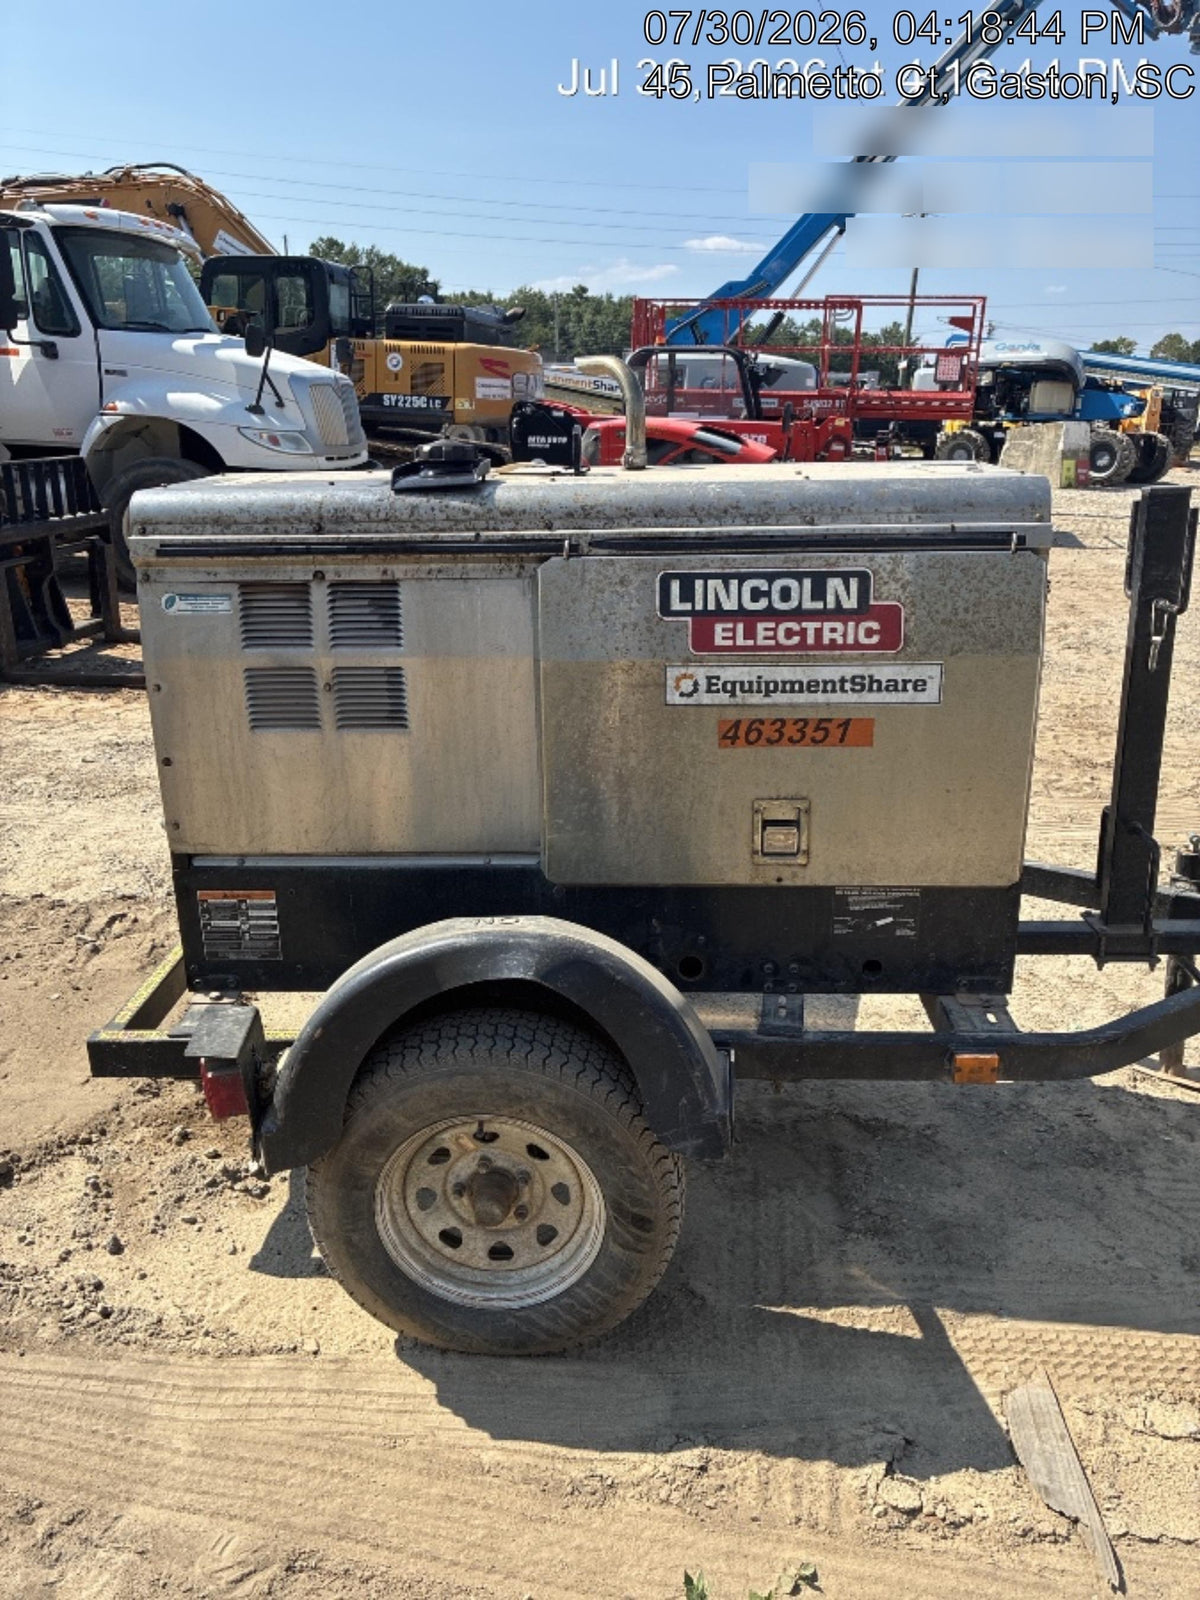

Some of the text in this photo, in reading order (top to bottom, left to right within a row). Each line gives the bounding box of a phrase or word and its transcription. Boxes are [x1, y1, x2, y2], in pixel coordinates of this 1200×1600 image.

[669, 576, 859, 612] LINCOLN
[713, 620, 881, 647] ELECTRIC
[704, 674, 928, 698] EquipmentShare
[720, 717, 854, 746] 463351
